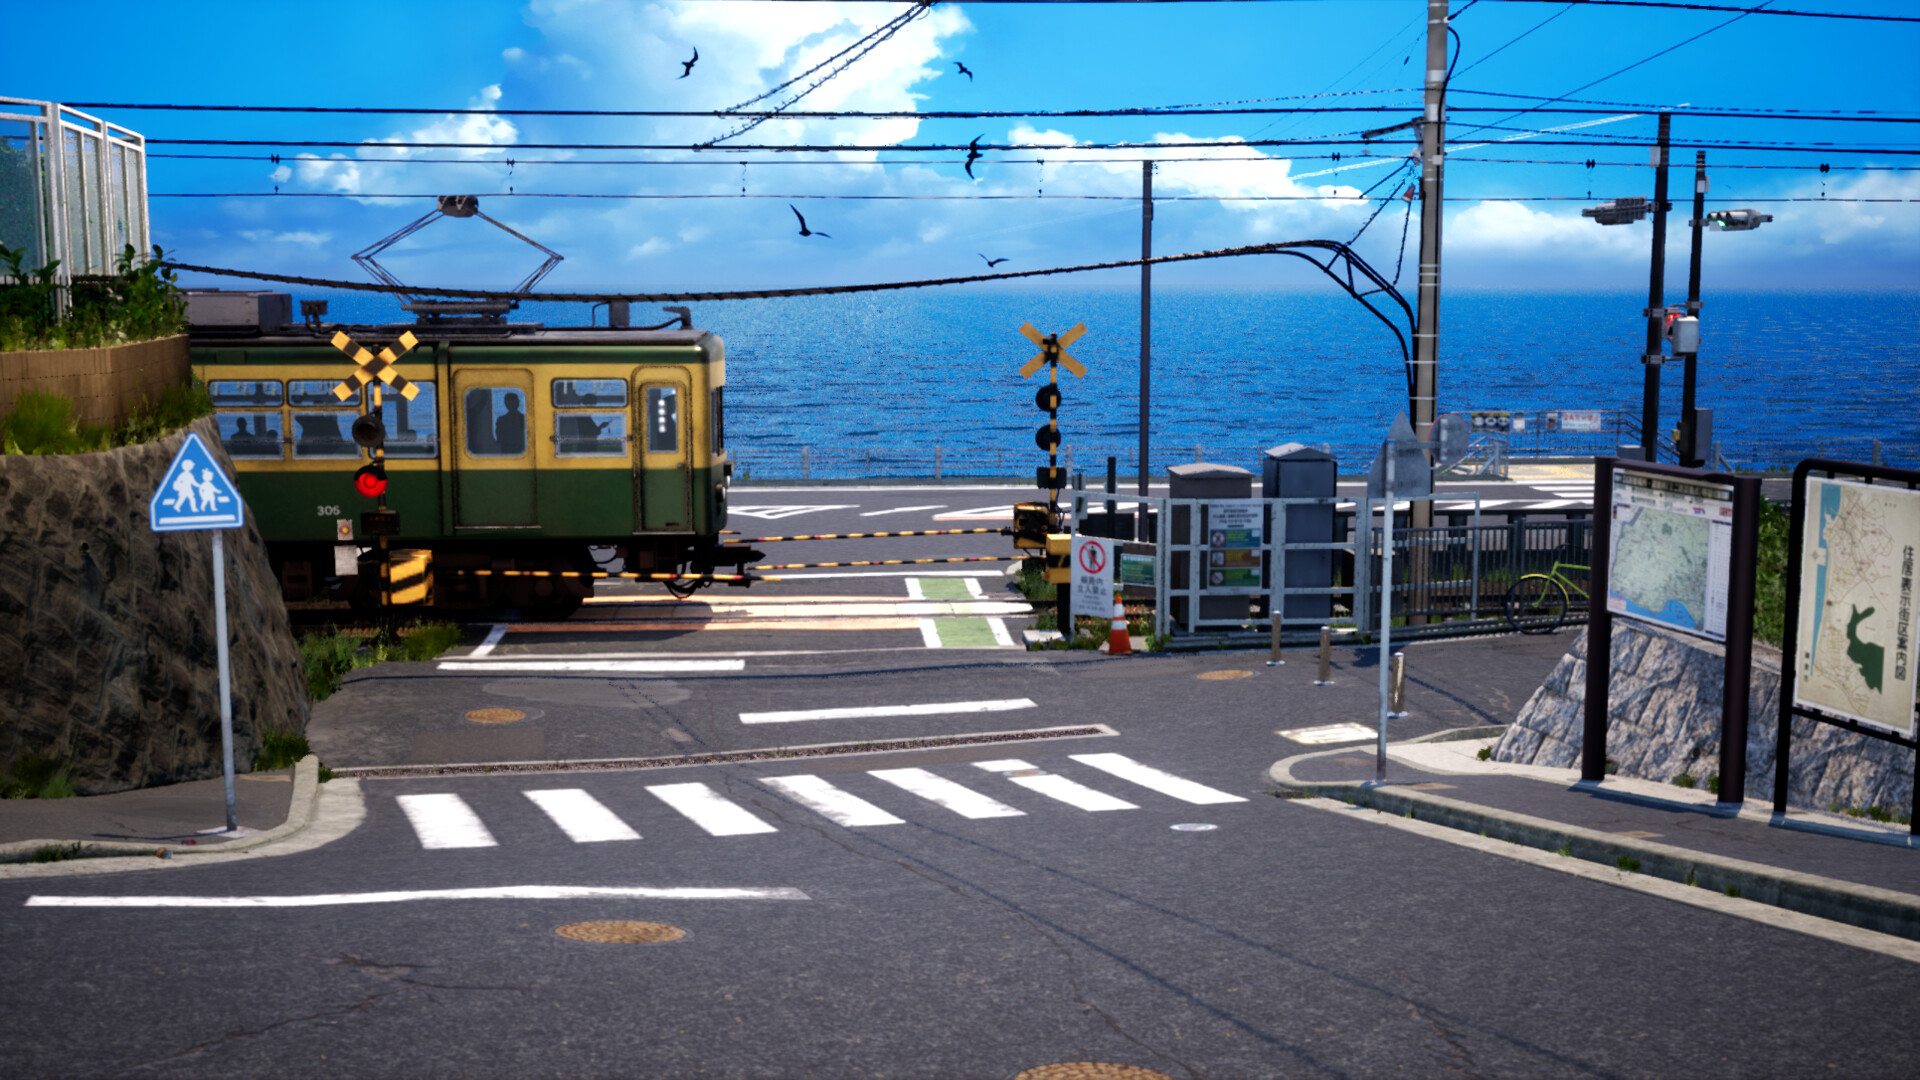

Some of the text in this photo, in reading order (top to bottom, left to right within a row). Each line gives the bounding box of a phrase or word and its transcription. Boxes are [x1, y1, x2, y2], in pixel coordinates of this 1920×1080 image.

[317, 505, 341, 516] 305
[1895, 544, 1914, 681] 住居表示街区案内図
